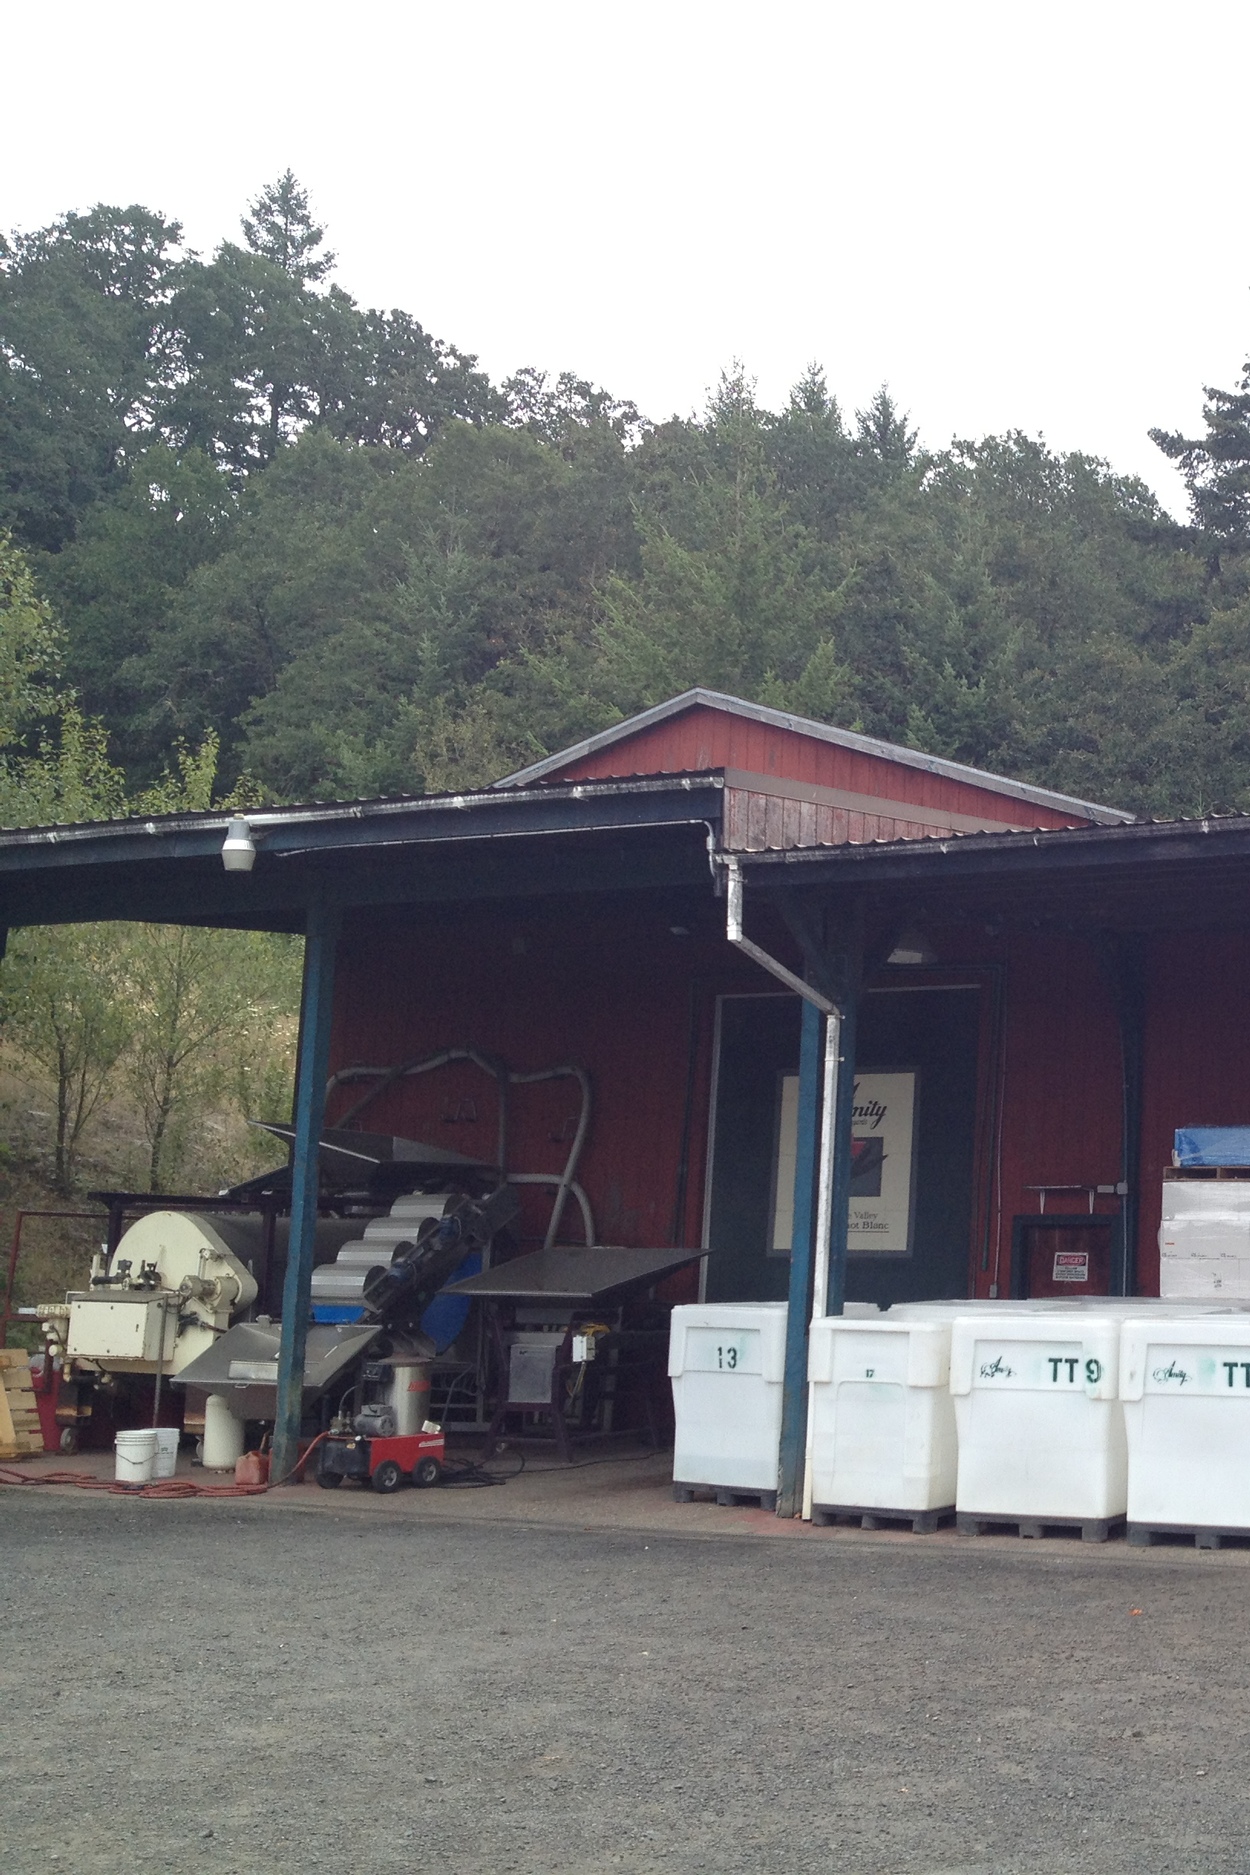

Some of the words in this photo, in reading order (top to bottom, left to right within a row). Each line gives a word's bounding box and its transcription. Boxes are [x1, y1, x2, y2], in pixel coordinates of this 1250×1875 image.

[854, 1211, 879, 1221] Valley
[862, 1221, 889, 1230] Blanc
[717, 1347, 738, 1369] 13
[1048, 1358, 1079, 1383] TT
[1085, 1359, 1102, 1383] 9
